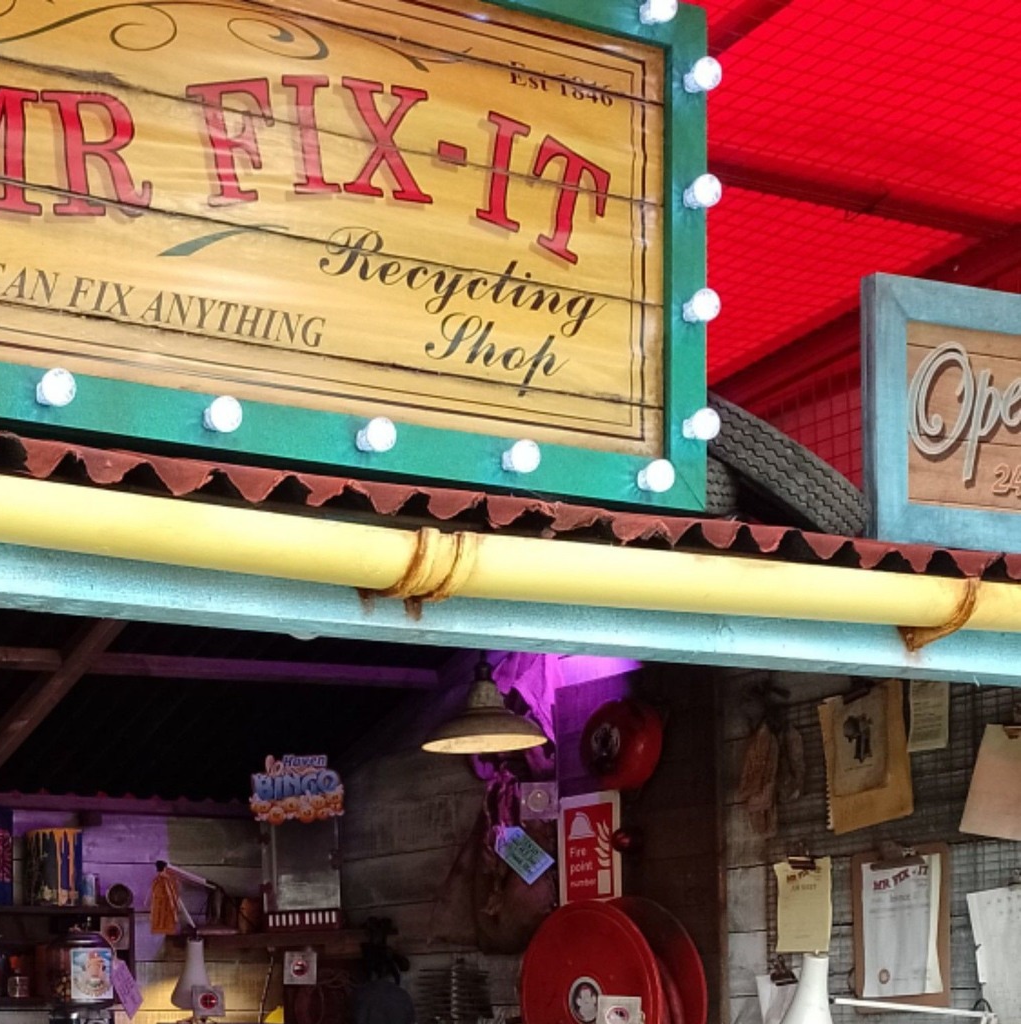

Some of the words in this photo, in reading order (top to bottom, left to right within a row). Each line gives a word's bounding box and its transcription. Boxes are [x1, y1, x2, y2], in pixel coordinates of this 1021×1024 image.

[509, 61, 548, 92] Est
[185, 74, 612, 265] FIX-IT
[319, 226, 607, 338] Recycling
[68, 275, 135, 317] FIX
[140, 290, 327, 349] ANYTHING
[425, 311, 570, 397] Shop
[908, 341, 1021, 482] Ope
[251, 769, 341, 802] BINGO
[569, 847, 587, 858] Fire
[570, 861, 594, 876] point
[570, 878, 597, 888] number
